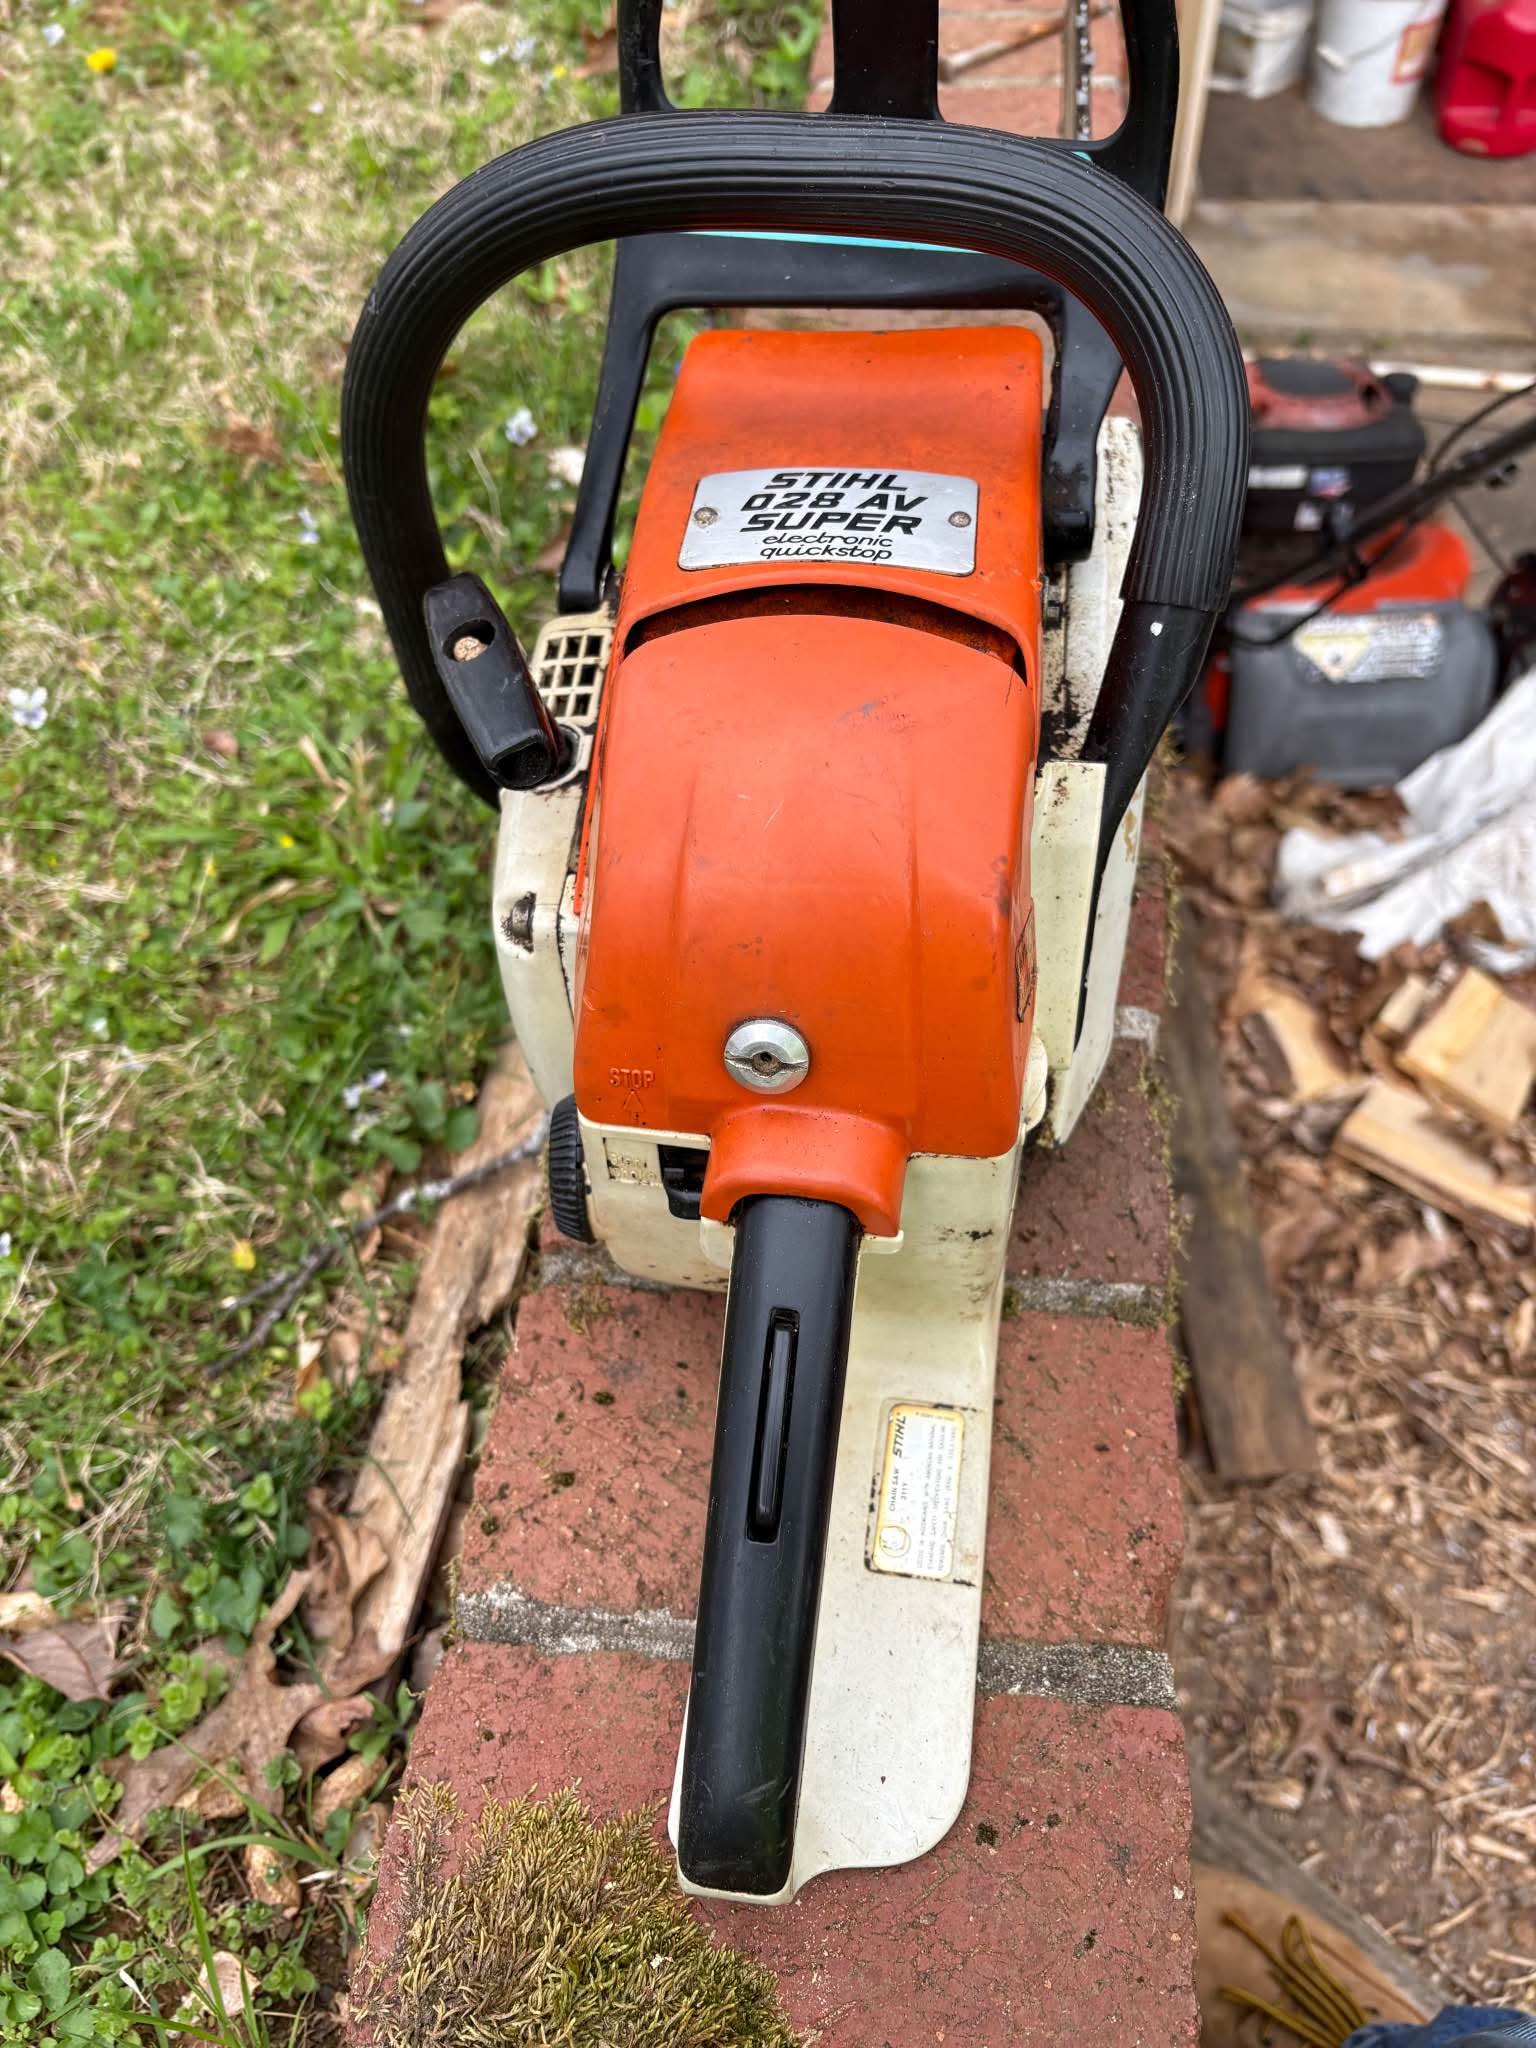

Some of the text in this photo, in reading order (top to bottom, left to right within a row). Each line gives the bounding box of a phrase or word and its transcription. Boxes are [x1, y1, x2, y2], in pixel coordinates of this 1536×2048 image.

[764, 472, 909, 491] STIHL
[740, 492, 929, 512] 028 AV
[739, 511, 923, 535] SUPER
[763, 532, 893, 547] electronic
[760, 544, 893, 561] quickstop
[609, 1067, 655, 1088] STOP
[892, 1415, 906, 1458] STIHL
[889, 1487, 897, 1512] CHAIN
